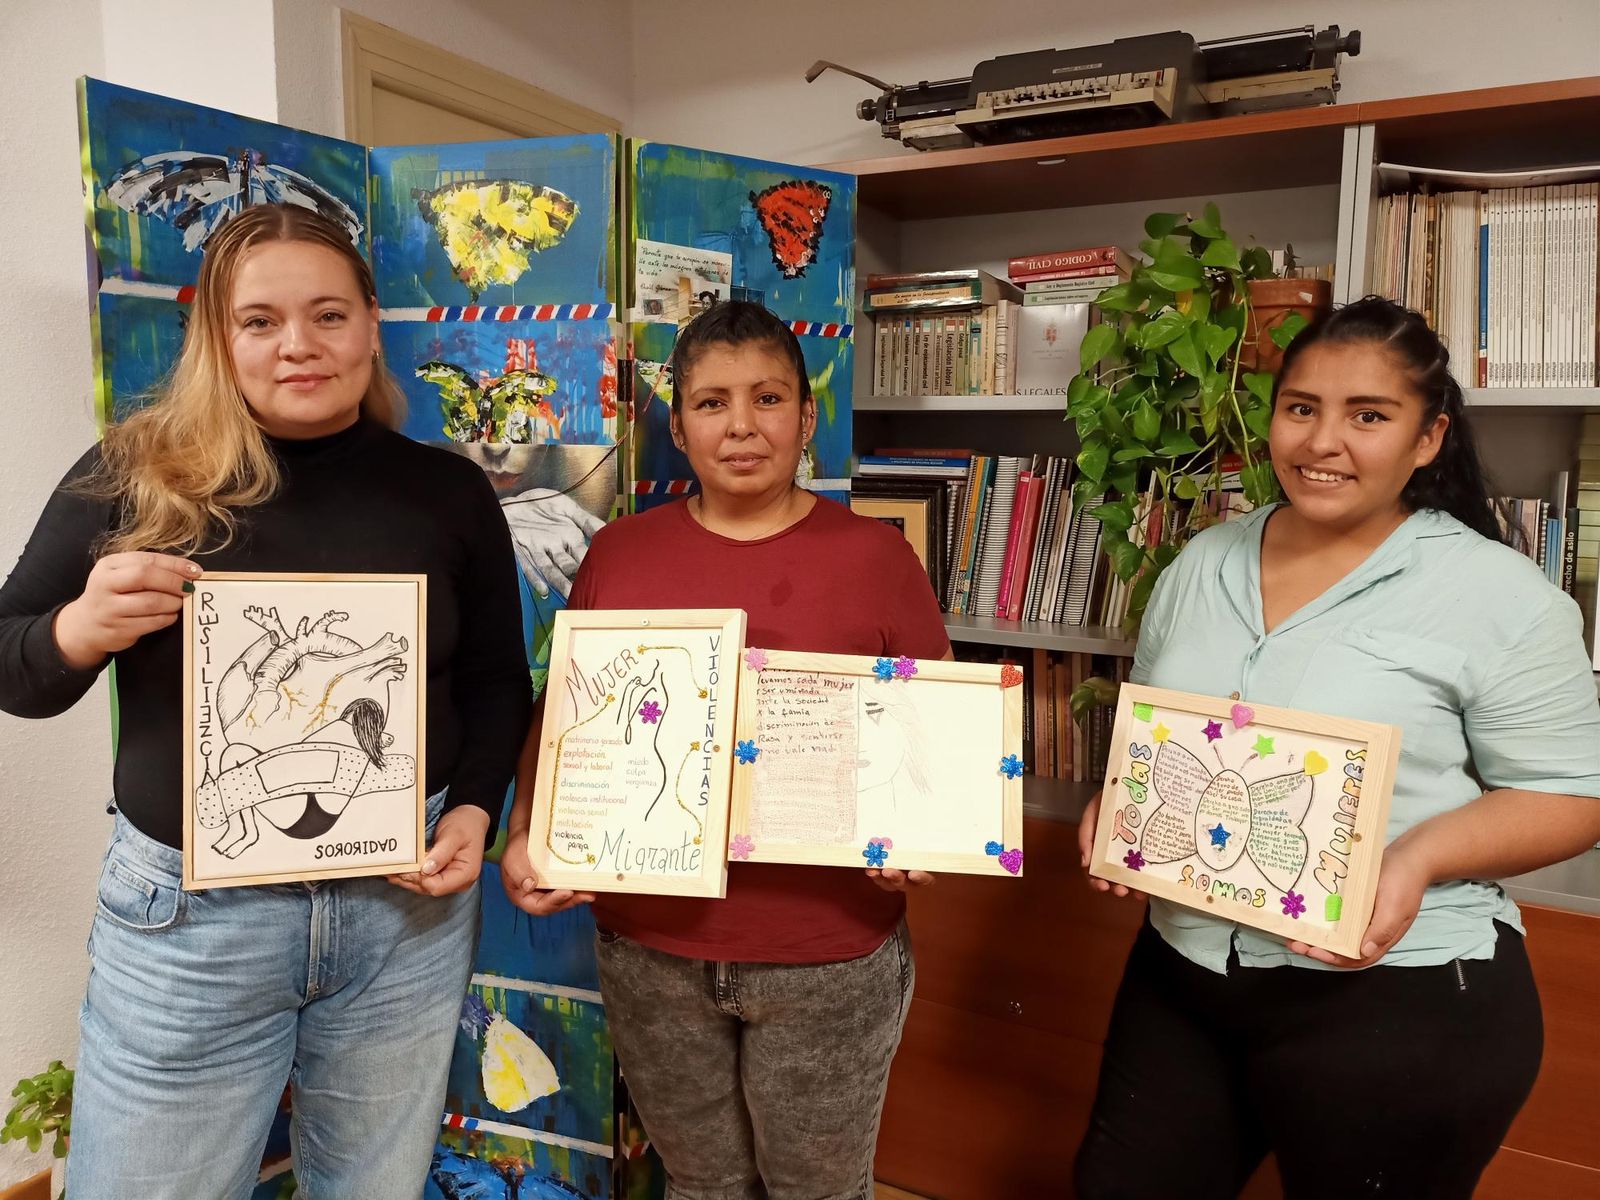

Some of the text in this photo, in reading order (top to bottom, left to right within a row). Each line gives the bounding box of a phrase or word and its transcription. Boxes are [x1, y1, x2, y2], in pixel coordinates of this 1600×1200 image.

[1027, 260, 1051, 269] CIVIL
[946, 333, 954, 365] Legislación
[1566, 532, 1574, 550] asilo
[1565, 553, 1573, 563] de
[565, 648, 639, 722] MUJER
[797, 675, 817, 684] cada
[824, 678, 854, 692] mujer
[198, 592, 219, 789] RESILIENCIA
[768, 707, 775, 715] la
[698, 635, 720, 806] VIOLENCIAS
[563, 748, 606, 761] explotación
[590, 761, 612, 770] laboral
[561, 778, 609, 789] discriminación
[559, 794, 627, 804] violencia institucional
[558, 807, 585, 815] violencia
[555, 831, 583, 841] violencia
[593, 828, 701, 875] Migrante
